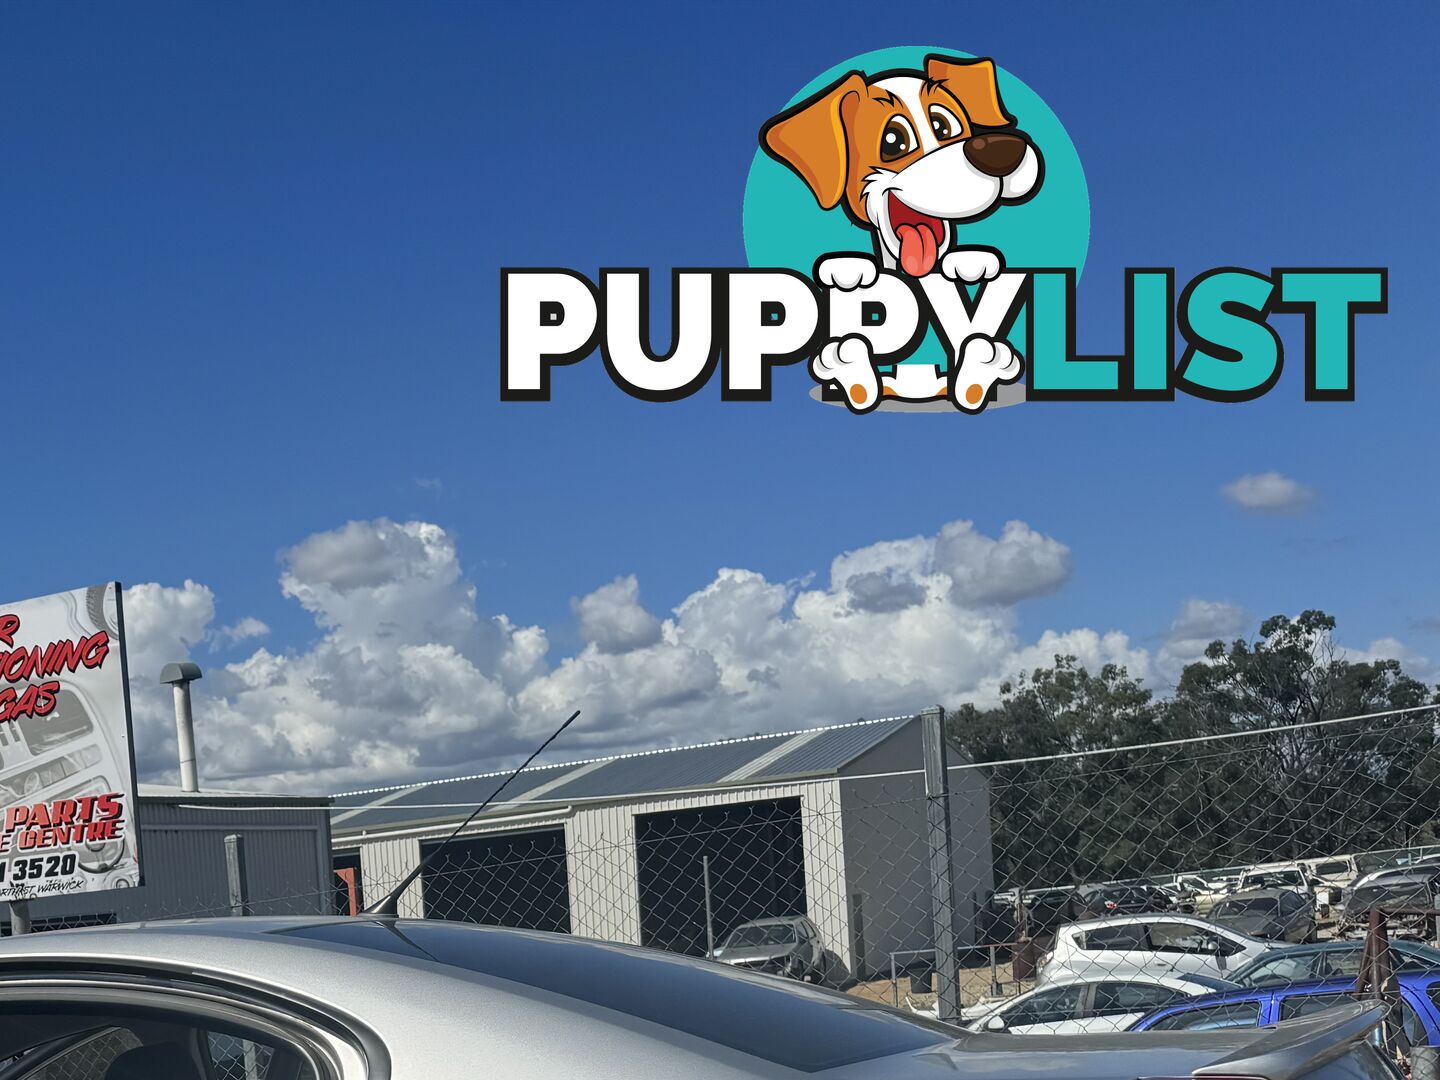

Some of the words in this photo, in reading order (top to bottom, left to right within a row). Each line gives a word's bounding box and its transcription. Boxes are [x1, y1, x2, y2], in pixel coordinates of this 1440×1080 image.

[5, 793, 124, 833] PARTS
[17, 819, 125, 850] CENTRE
[12, 853, 77, 881] 3520
[37, 880, 84, 893] WARWICK
